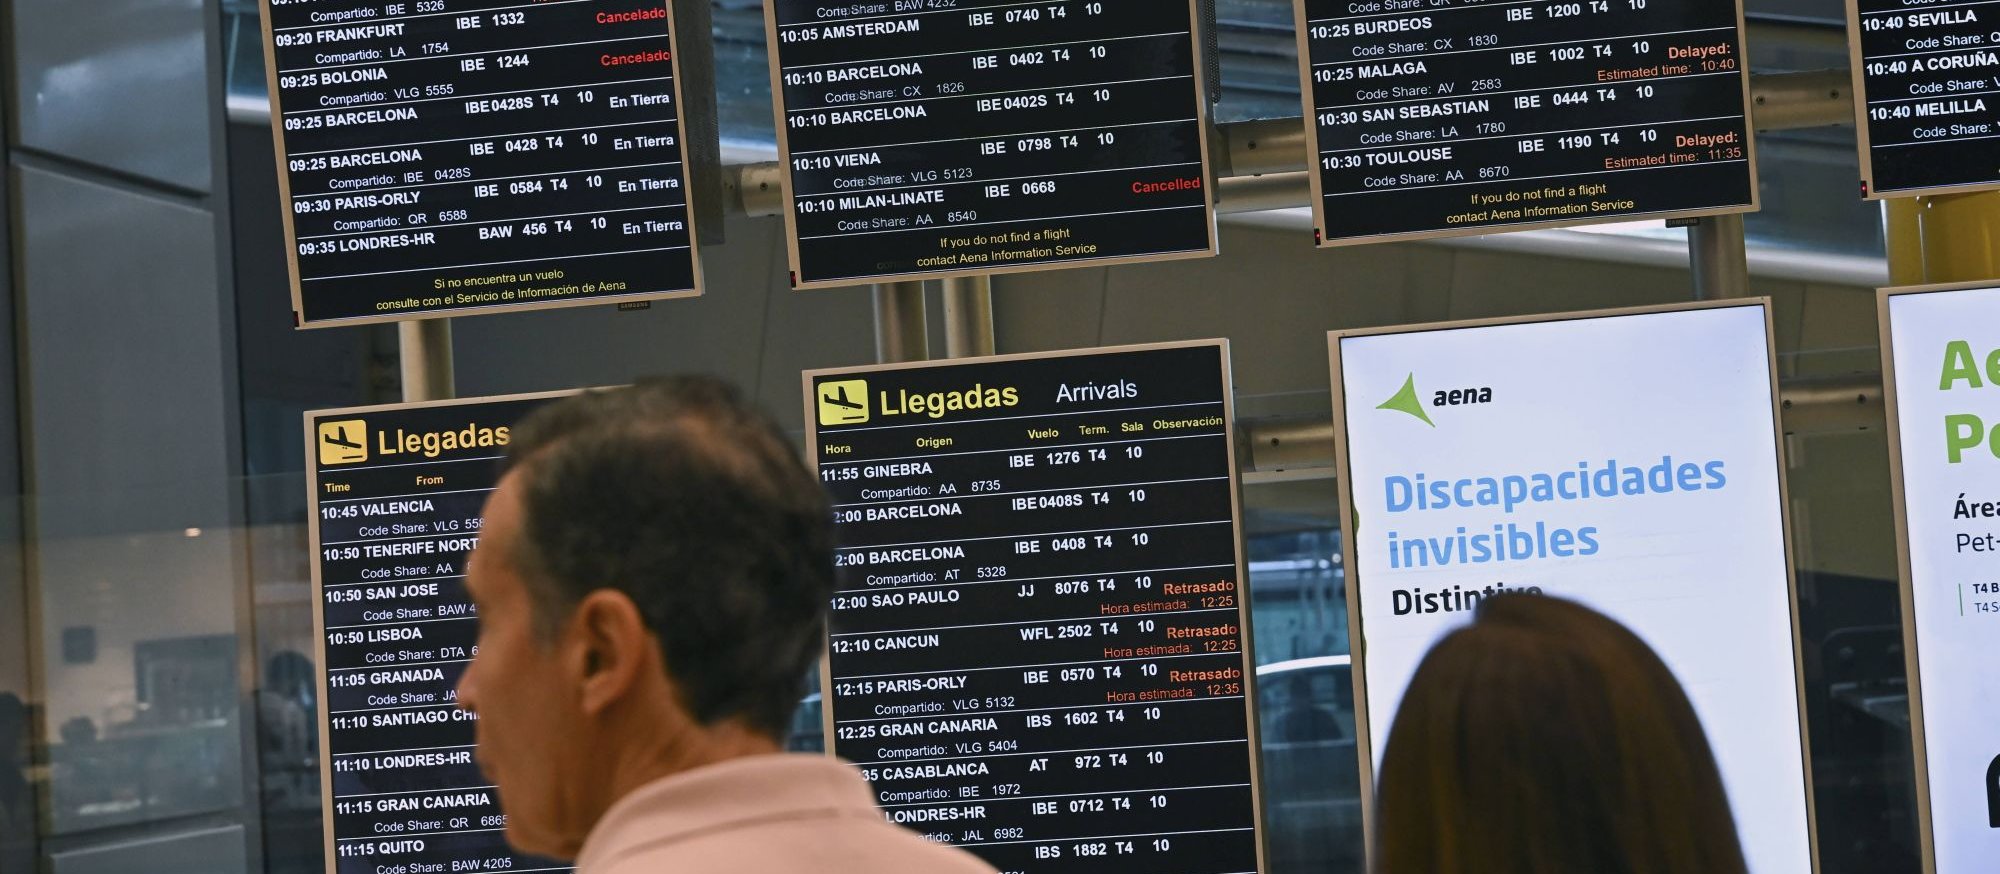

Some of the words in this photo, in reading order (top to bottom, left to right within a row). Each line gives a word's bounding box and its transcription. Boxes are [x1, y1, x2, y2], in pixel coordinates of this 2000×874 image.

[276, 32, 313, 47] 09:20
[316, 23, 405, 43] FRANKFURT
[456, 15, 481, 30] IBE
[492, 12, 525, 26] 1332
[596, 7, 666, 24] Cancelado
[781, 28, 819, 43] 10:05
[823, 19, 920, 40] AMSTERDAM
[969, 12, 994, 26] IBE
[1006, 8, 1040, 23] 0740
[1048, 6, 1066, 19] T4
[1085, 2, 1102, 15] 10
[1863, 16, 1904, 31] 10:40
[1908, 9, 1978, 28] SEVILLA
[315, 49, 383, 64] Compartido:
[390, 46, 406, 58] LA
[422, 42, 449, 54] 1754
[1906, 37, 1940, 50] Code
[1943, 34, 1985, 47] Share:
[280, 74, 318, 89] 09:25
[321, 67, 388, 85] BOLONIA
[461, 58, 486, 72] IBE
[497, 54, 530, 69] 1244
[600, 50, 671, 66] Cancelado
[1314, 67, 1354, 83] 10:25
[1358, 61, 1427, 79] MALAGA
[1511, 51, 1537, 65] IBE
[1550, 47, 1585, 62] 1002
[1593, 44, 1612, 58] T4
[1632, 41, 1650, 54] 10
[1669, 42, 1730, 59] Delayed:
[1598, 66, 1658, 81] Estimated
[1662, 64, 1692, 75] time:
[1701, 58, 1735, 72] 10:40
[1867, 60, 1907, 76] 10:40
[1912, 59, 1924, 73] A
[1927, 50, 1999, 71] CORUÑA
[320, 90, 387, 106] Compartido:
[394, 87, 420, 99] VLG
[426, 83, 454, 96] 5555
[1357, 89, 1388, 101] Code
[1392, 85, 1432, 98] Share:
[1438, 82, 1454, 94] AV
[1472, 78, 1502, 91] 2583
[1318, 111, 1358, 126] 10:30
[1362, 108, 1395, 122] SAN
[1399, 99, 1489, 119] SEBASTIAN
[1514, 95, 1541, 109] IBE
[1553, 90, 1589, 106] 0444
[1597, 88, 1616, 102] T4
[1636, 85, 1654, 99] 10
[1870, 105, 1911, 121] 10:40
[1915, 98, 1987, 117] MELILLA
[793, 156, 831, 171] 10:10
[834, 152, 881, 168] VIENA
[981, 141, 1006, 155] IBE
[1018, 137, 1052, 152] 0798
[1060, 135, 1078, 148] T4
[1097, 132, 1114, 145] 10
[797, 199, 835, 214] 10:10
[839, 189, 945, 210] MILAN-LINATE
[985, 184, 1010, 198] IBE
[1022, 180, 1056, 195] 0668
[1132, 177, 1201, 194] Cancelled
[838, 220, 868, 231] Code
[872, 216, 910, 228] Share:
[916, 214, 933, 225] AA
[948, 210, 977, 223] 8540
[298, 240, 336, 256] 09:35
[340, 232, 436, 252] LONDRES-HR
[479, 225, 513, 240] BAW
[523, 222, 548, 236] 456
[554, 219, 573, 233] T4
[590, 216, 607, 230] 10
[623, 222, 641, 235] En
[644, 220, 683, 233] Tierra
[917, 255, 957, 267] contact
[959, 253, 988, 264] Aena
[991, 248, 1053, 261] Information
[1055, 244, 1097, 256] Service
[434, 279, 445, 289] Si
[447, 279, 462, 288] no
[464, 274, 516, 287] encuentra
[519, 273, 533, 282] un
[535, 269, 564, 280] vuelo
[376, 298, 420, 310] consulte
[422, 297, 442, 306] con
[444, 294, 454, 305] el
[456, 292, 499, 304] Servicio
[501, 290, 515, 300] de
[517, 284, 579, 299] Información
[581, 283, 595, 293] de
[598, 281, 626, 292] Aena
[881, 383, 1019, 419] Llegadas
[1056, 378, 1138, 403] Arrivals
[1433, 387, 1492, 407] aena
[379, 423, 512, 458] Llegadas
[826, 444, 851, 454] Hora
[916, 437, 953, 449] Origen
[1028, 428, 1059, 439] Vuelo
[1079, 425, 1110, 435] Term.
[1121, 421, 1144, 432] Sala
[1153, 416, 1223, 430] Observación
[822, 467, 859, 482] 11:55
[864, 462, 933, 478] GINEBRA
[1009, 454, 1035, 468] IBE
[1047, 450, 1080, 465] 1276
[1088, 448, 1107, 462] T4
[1126, 446, 1143, 459] 10
[325, 483, 351, 493] Time
[416, 476, 444, 486] From
[861, 485, 931, 500] Compartido:
[939, 483, 957, 495] AA
[972, 479, 1001, 492] 8735
[1384, 455, 1727, 513] Discapacidades
[321, 505, 358, 520] 10:45
[361, 500, 435, 516] VALENCIA
[358, 525, 389, 537] Code
[391, 523, 429, 535] Share:
[433, 519, 459, 532] VLG
[1388, 521, 1599, 568] invisibles
[326, 589, 362, 603] 10:50
[365, 586, 396, 600] SAN
[400, 583, 439, 597] JOSE
[1973, 583, 1988, 594] T4
[1974, 602, 1989, 613] T4
[328, 631, 364, 645] 10:50
[368, 627, 423, 643] LISBOA
[832, 639, 870, 653] 12:10
[874, 634, 939, 651] CANCUN
[1020, 627, 1054, 641] WFL
[1058, 624, 1092, 639] 2502
[1100, 622, 1119, 635] T4
[1138, 619, 1155, 633] 10
[1167, 623, 1237, 639] Retrasado
[1104, 648, 1133, 658] Hora
[1136, 643, 1193, 656] estimada:
[1204, 639, 1236, 652] 12:25
[330, 673, 366, 688] 11:05
[370, 668, 445, 685] GRANADA
[338, 842, 375, 857] 11:15
[379, 839, 425, 855] QUITO
